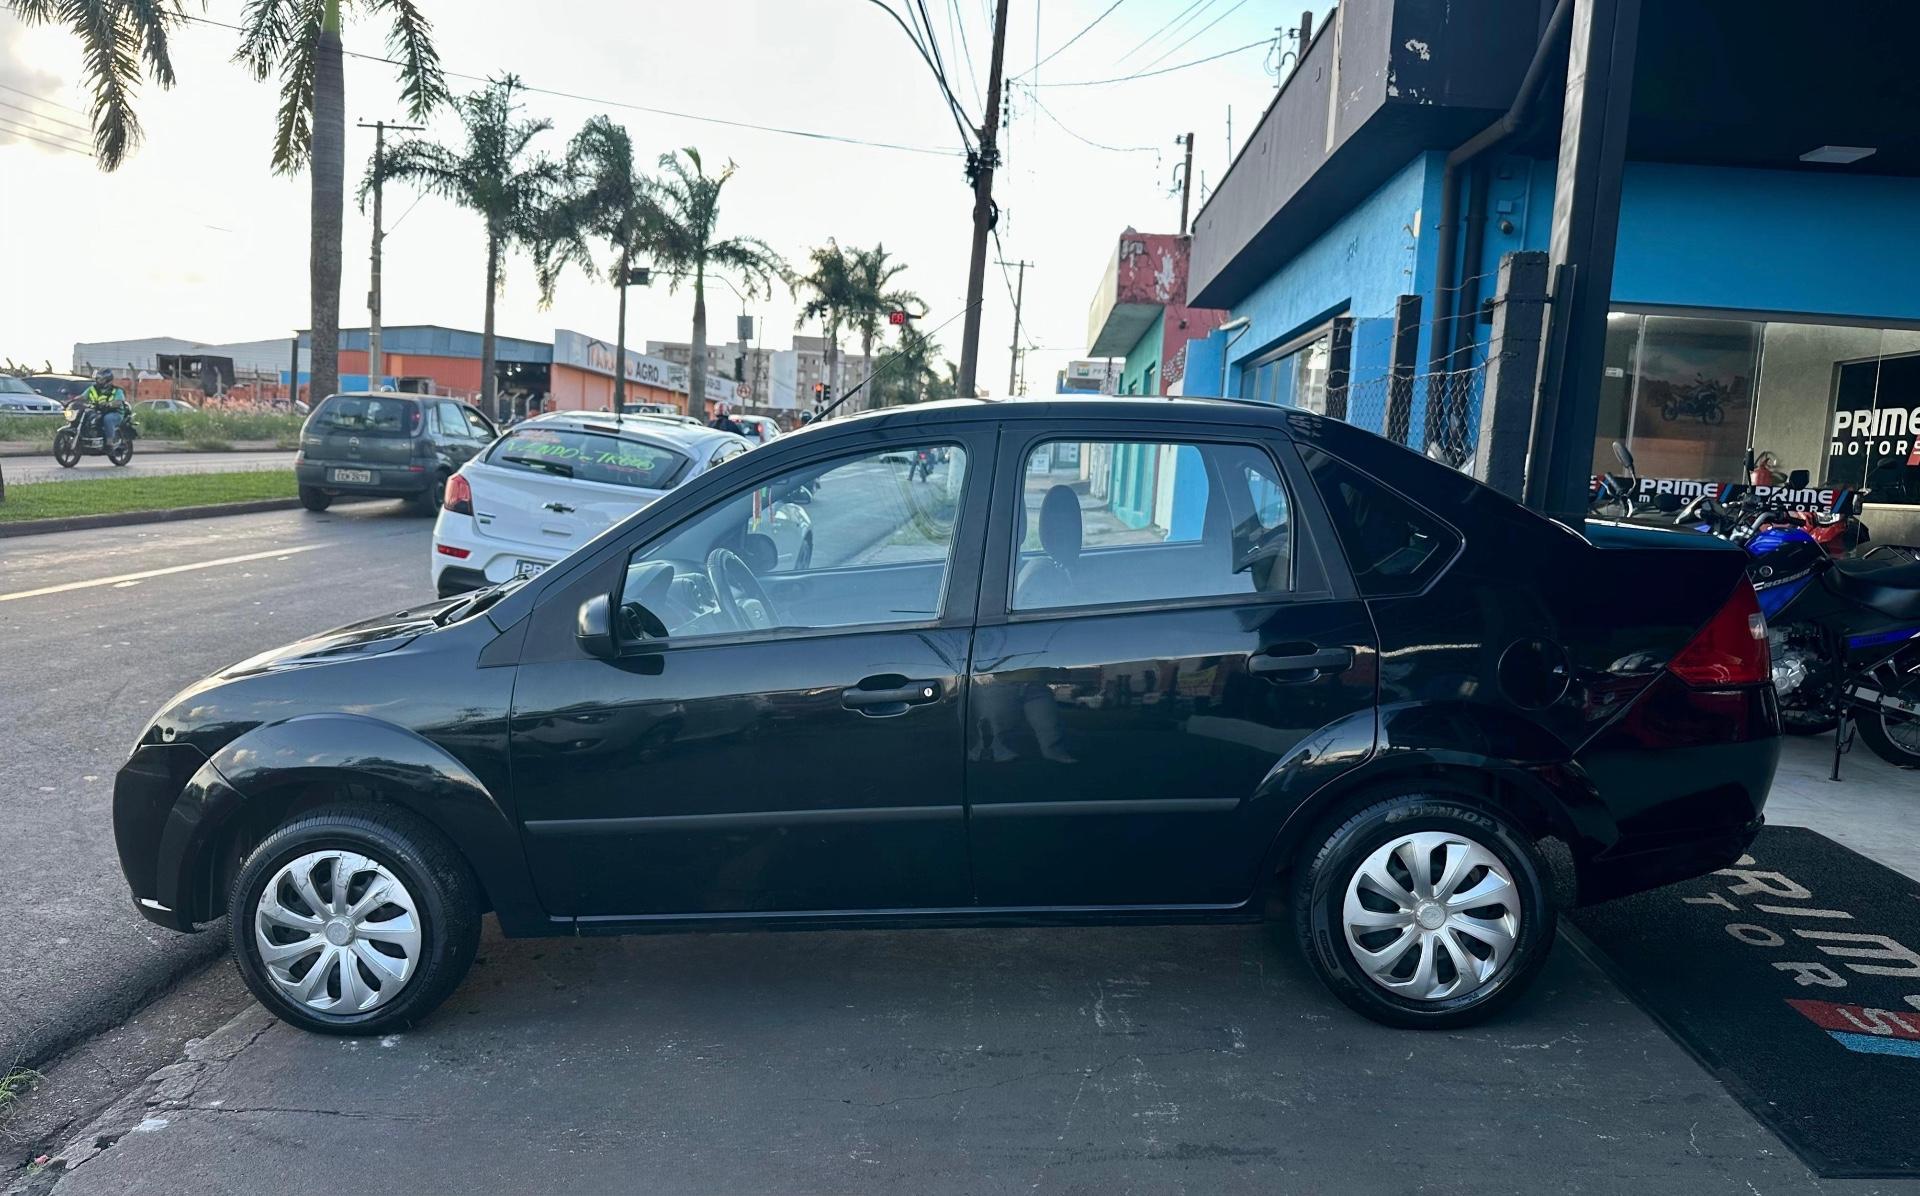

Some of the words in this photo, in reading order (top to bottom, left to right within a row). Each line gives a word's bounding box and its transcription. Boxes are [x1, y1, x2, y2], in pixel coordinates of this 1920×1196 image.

[636, 361, 660, 383] AGRO
[1832, 407, 1920, 438] PRIME
[1639, 479, 1719, 498] PRIME
[1755, 486, 1834, 505] PRIME
[1756, 501, 1832, 514] OTORS
[1710, 853, 1920, 1010] RIM
[1682, 892, 1919, 1036] TORS
